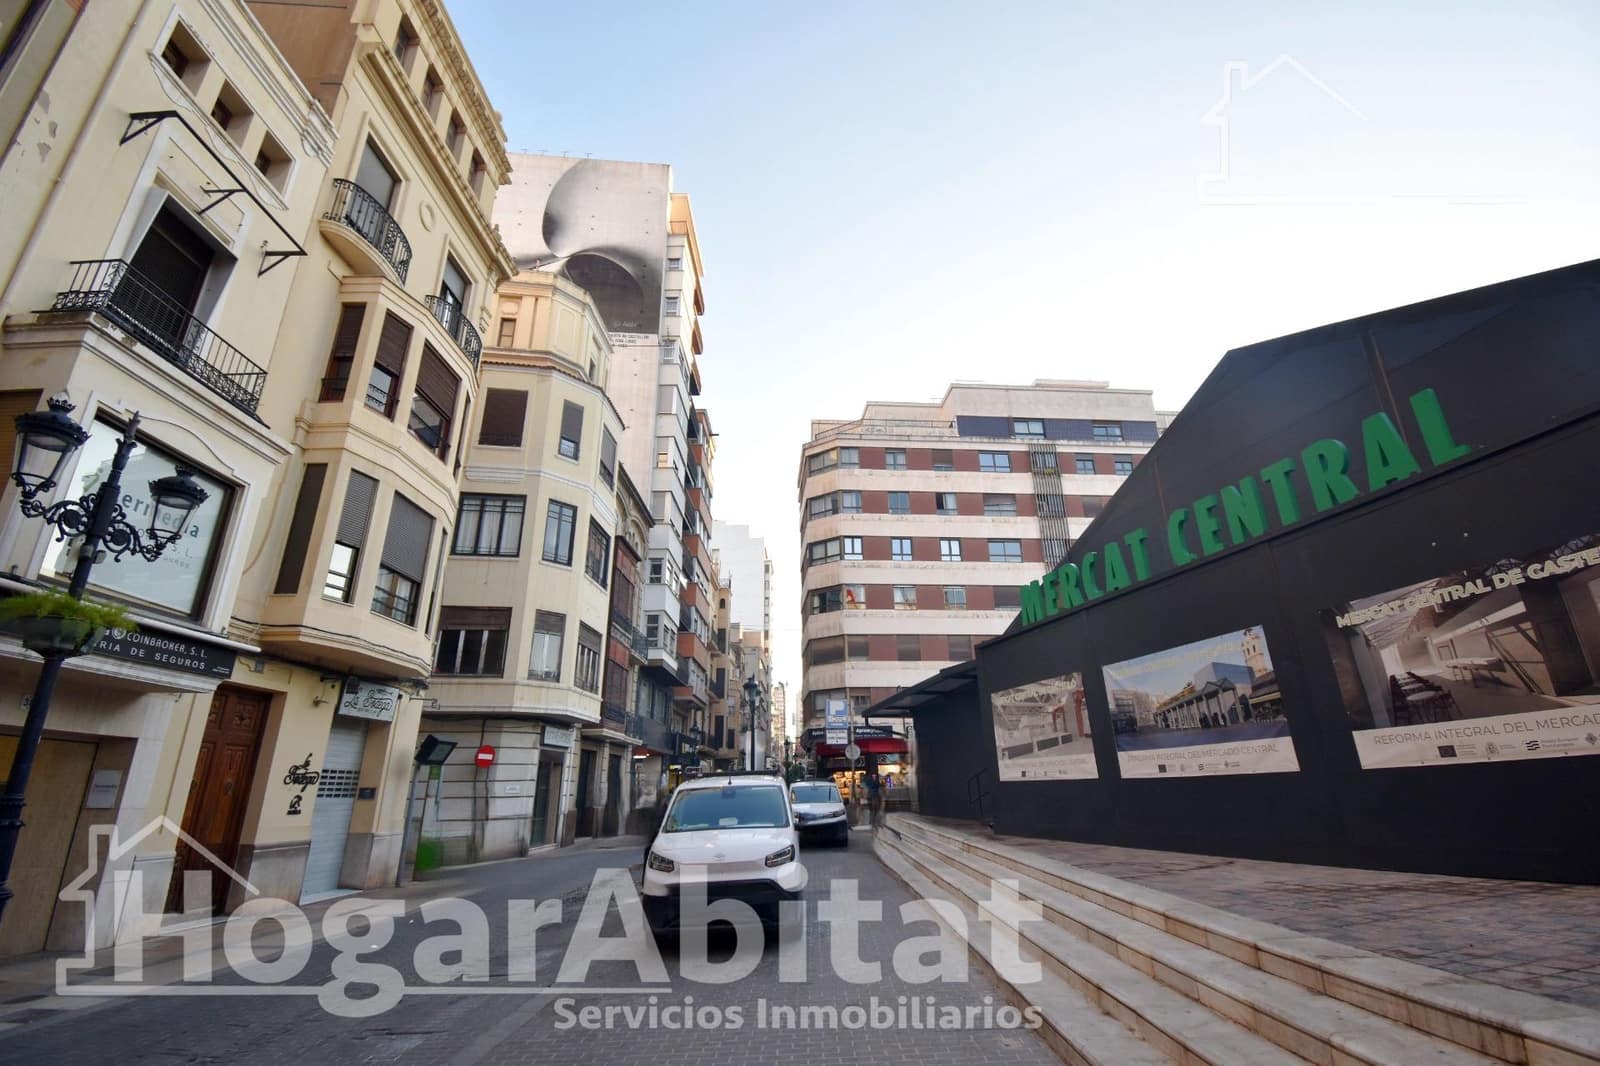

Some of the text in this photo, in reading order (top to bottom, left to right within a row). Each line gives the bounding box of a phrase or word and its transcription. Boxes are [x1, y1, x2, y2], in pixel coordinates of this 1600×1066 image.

[1019, 387, 1473, 627] MERCAT CENTRAL
[1404, 578, 1492, 611] CENTRAL
[1492, 567, 1526, 589] DE
[130, 647, 146, 658] DE
[154, 652, 206, 670] SEGUROS
[1374, 730, 1433, 746] REFORMA
[1434, 724, 1501, 741] INTEGRAL
[1503, 720, 1534, 734] DEL
